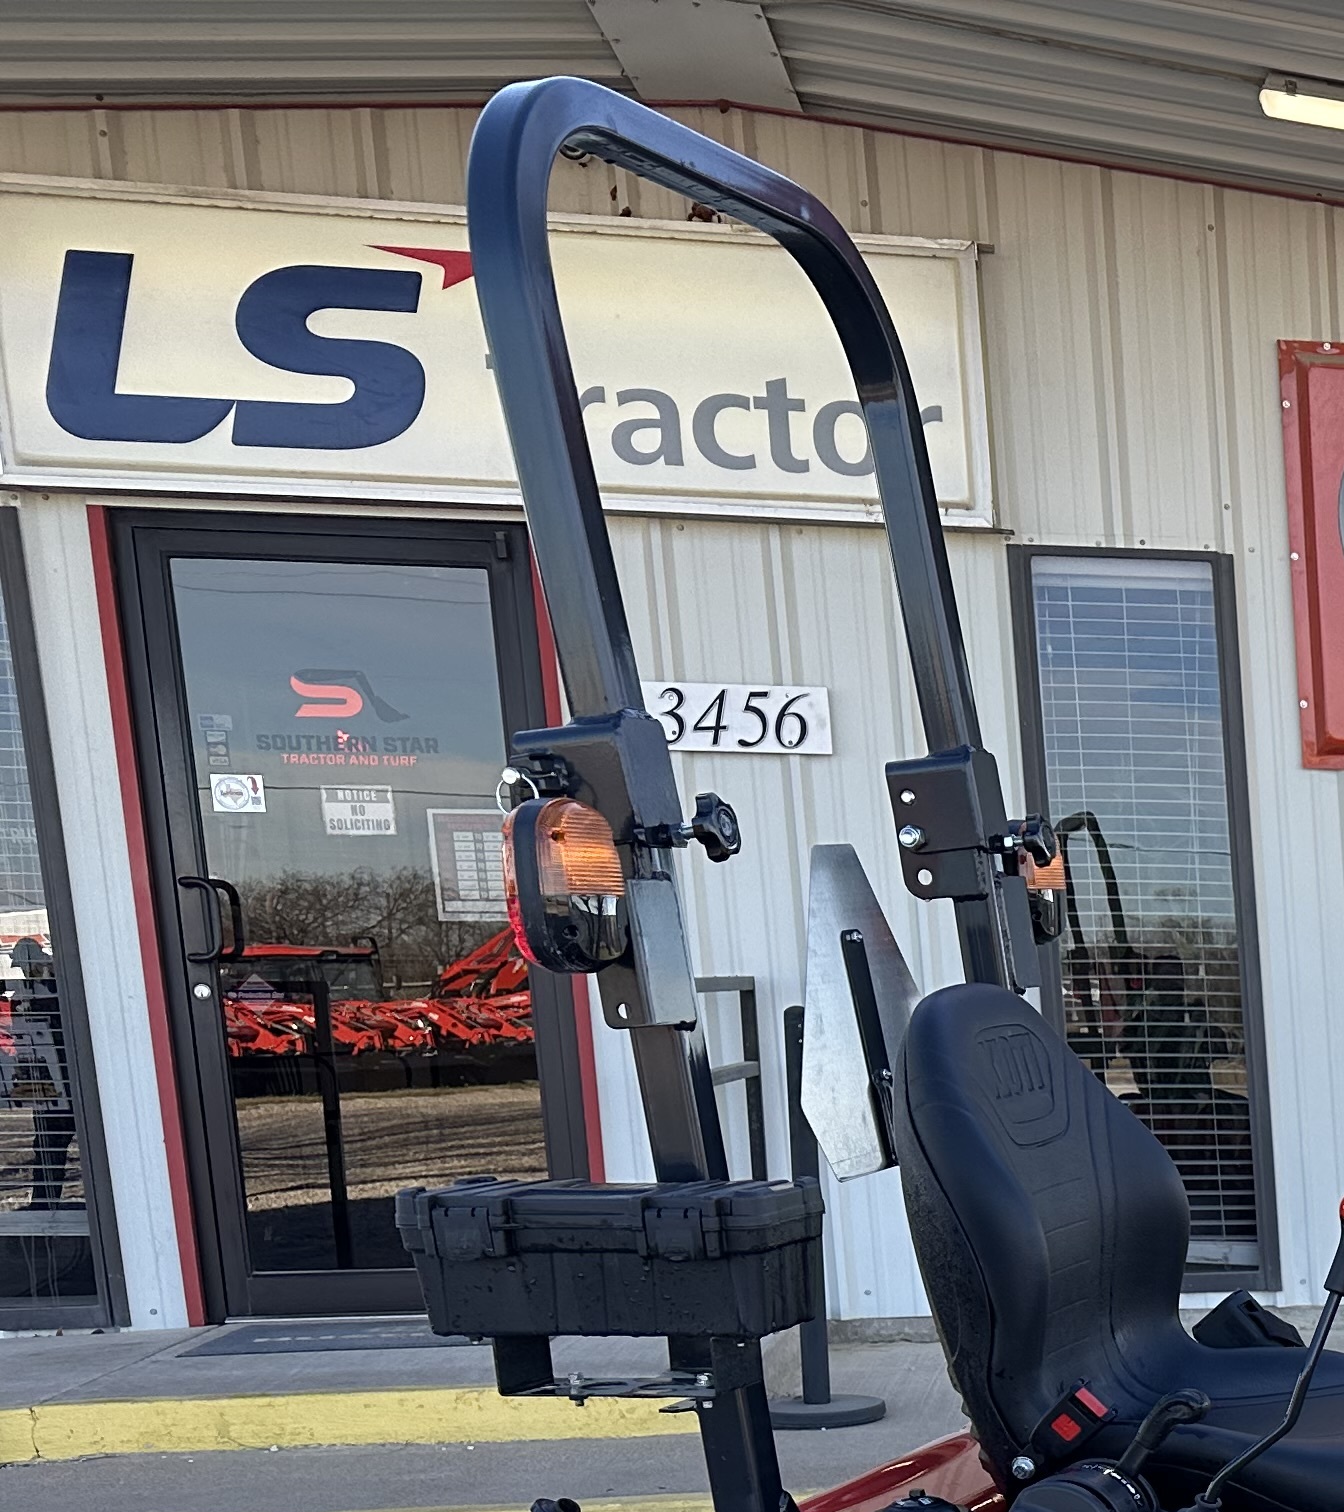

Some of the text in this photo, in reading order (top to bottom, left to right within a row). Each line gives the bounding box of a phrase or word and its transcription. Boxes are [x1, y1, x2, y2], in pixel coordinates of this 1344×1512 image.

[46, 247, 943, 477] LS racto
[659, 687, 810, 749] 3456
[256, 733, 439, 755] SOUTHERN STAR
[281, 753, 417, 767] TRACTOR AND TURF
[336, 789, 377, 801] NOTICE
[350, 804, 366, 817] NO
[329, 818, 391, 831] SOLICITING
